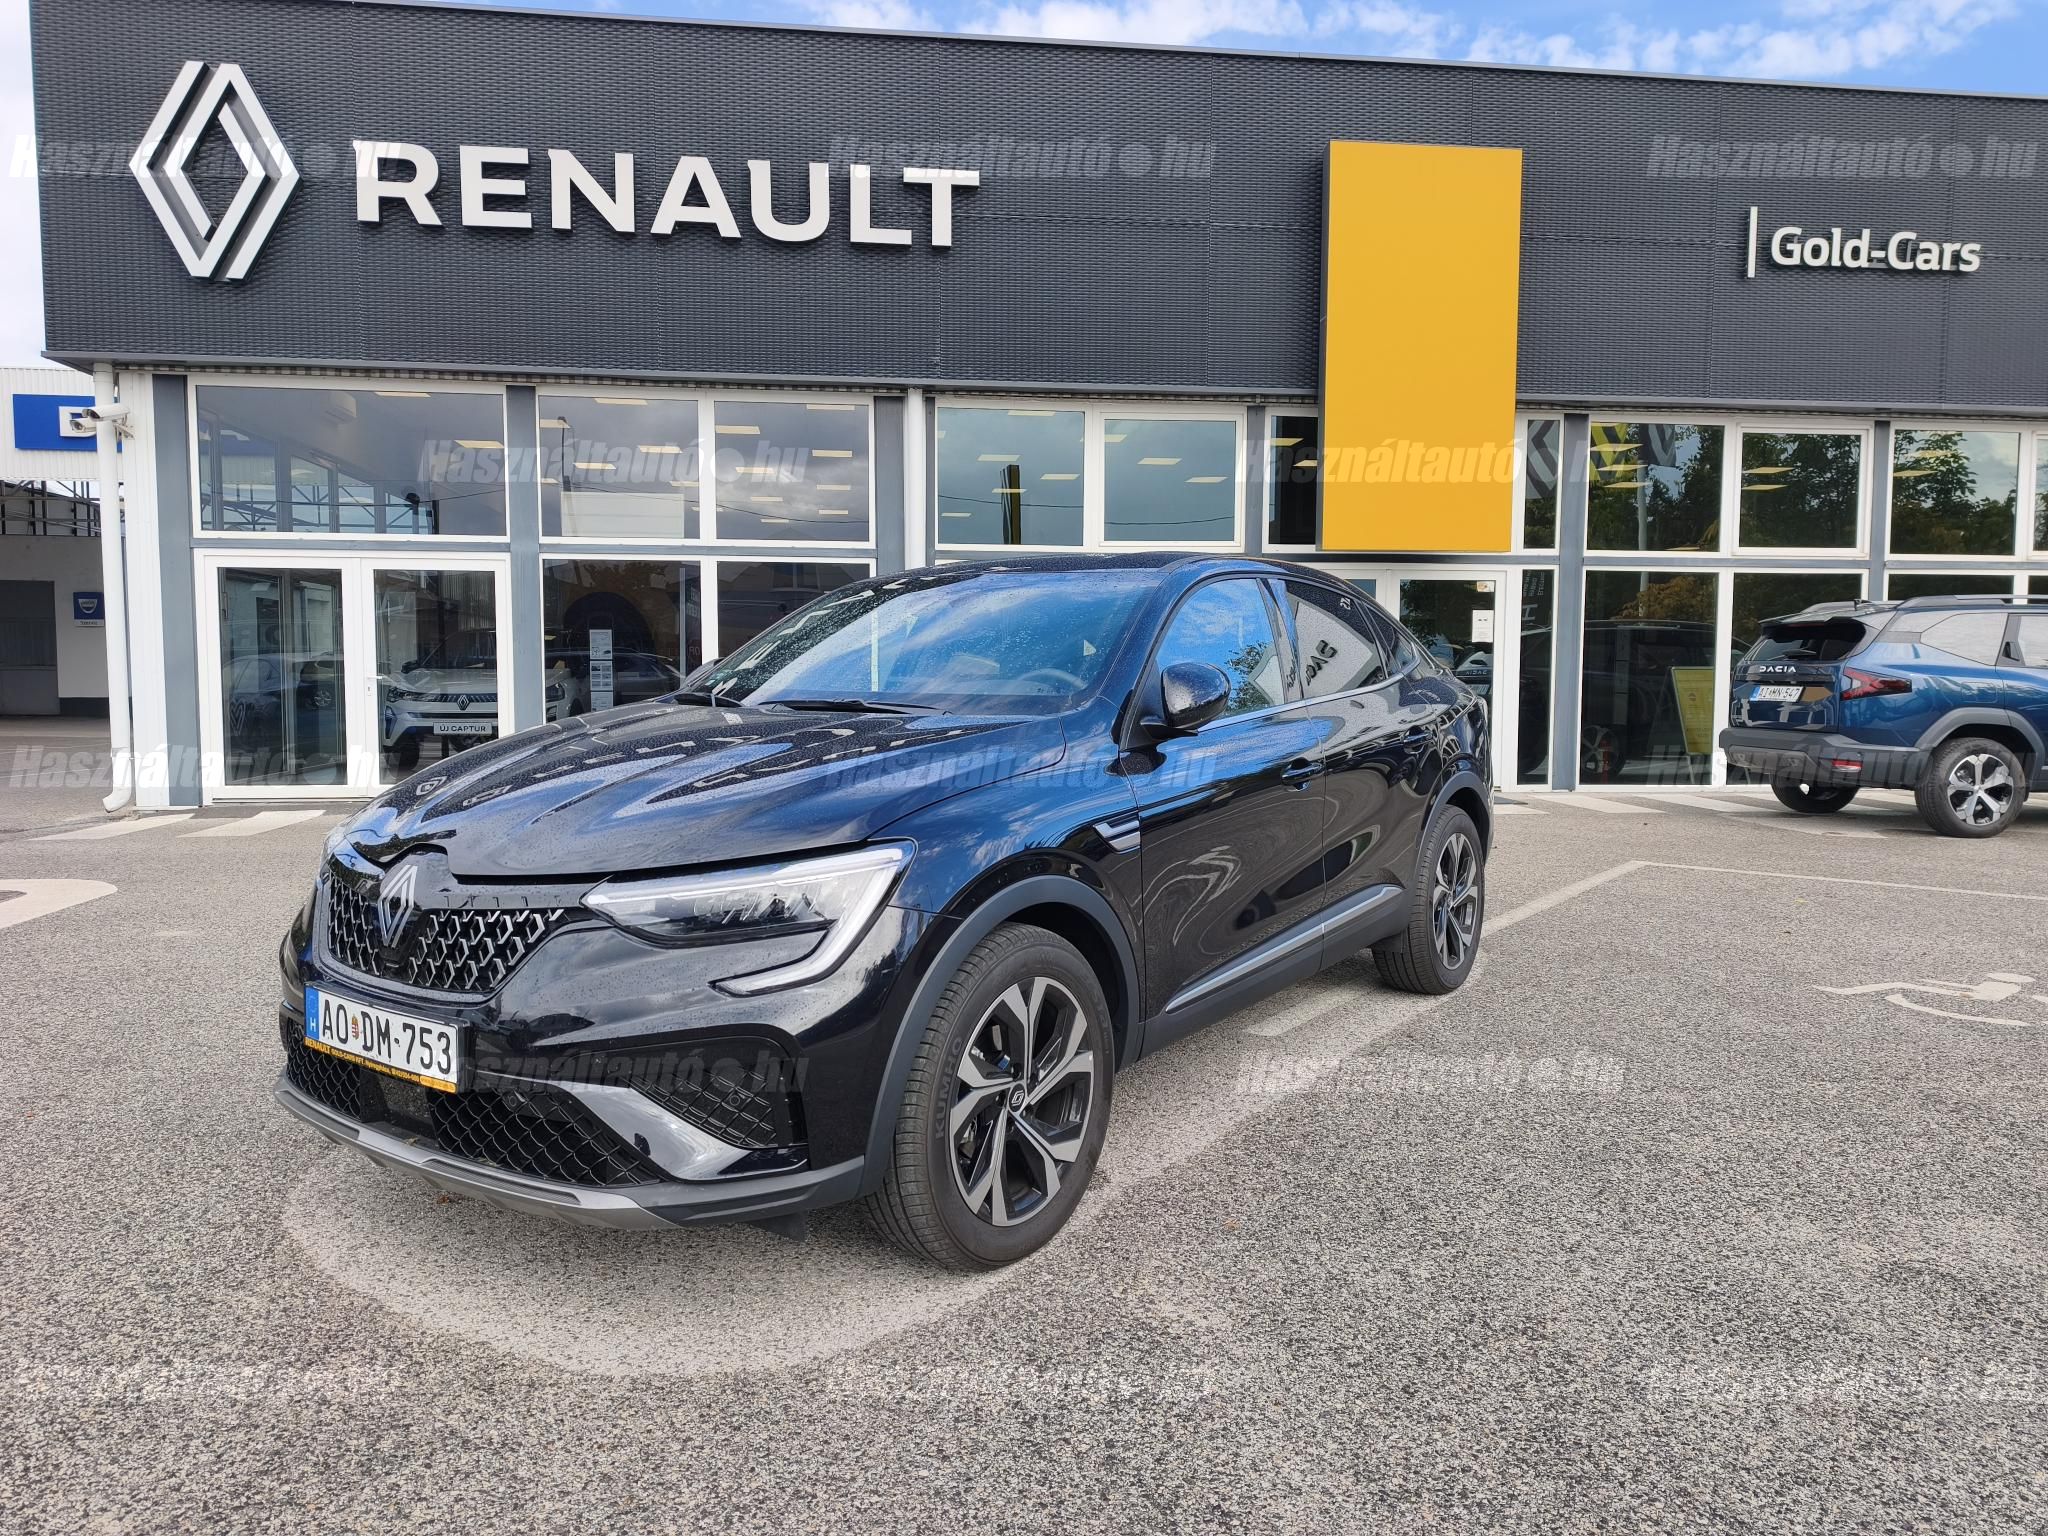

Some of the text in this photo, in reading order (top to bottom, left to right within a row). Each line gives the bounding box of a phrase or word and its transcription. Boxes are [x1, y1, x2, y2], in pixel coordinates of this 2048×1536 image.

[352, 140, 981, 247] RENAULT
[1771, 226, 1982, 273] Gold-Cars
[1760, 665, 1797, 673] DACIA
[439, 723, 449, 732] ÚJ
[304, 1037, 331, 1054] RENAULT
[935, 1036, 963, 1140] KUMHO
